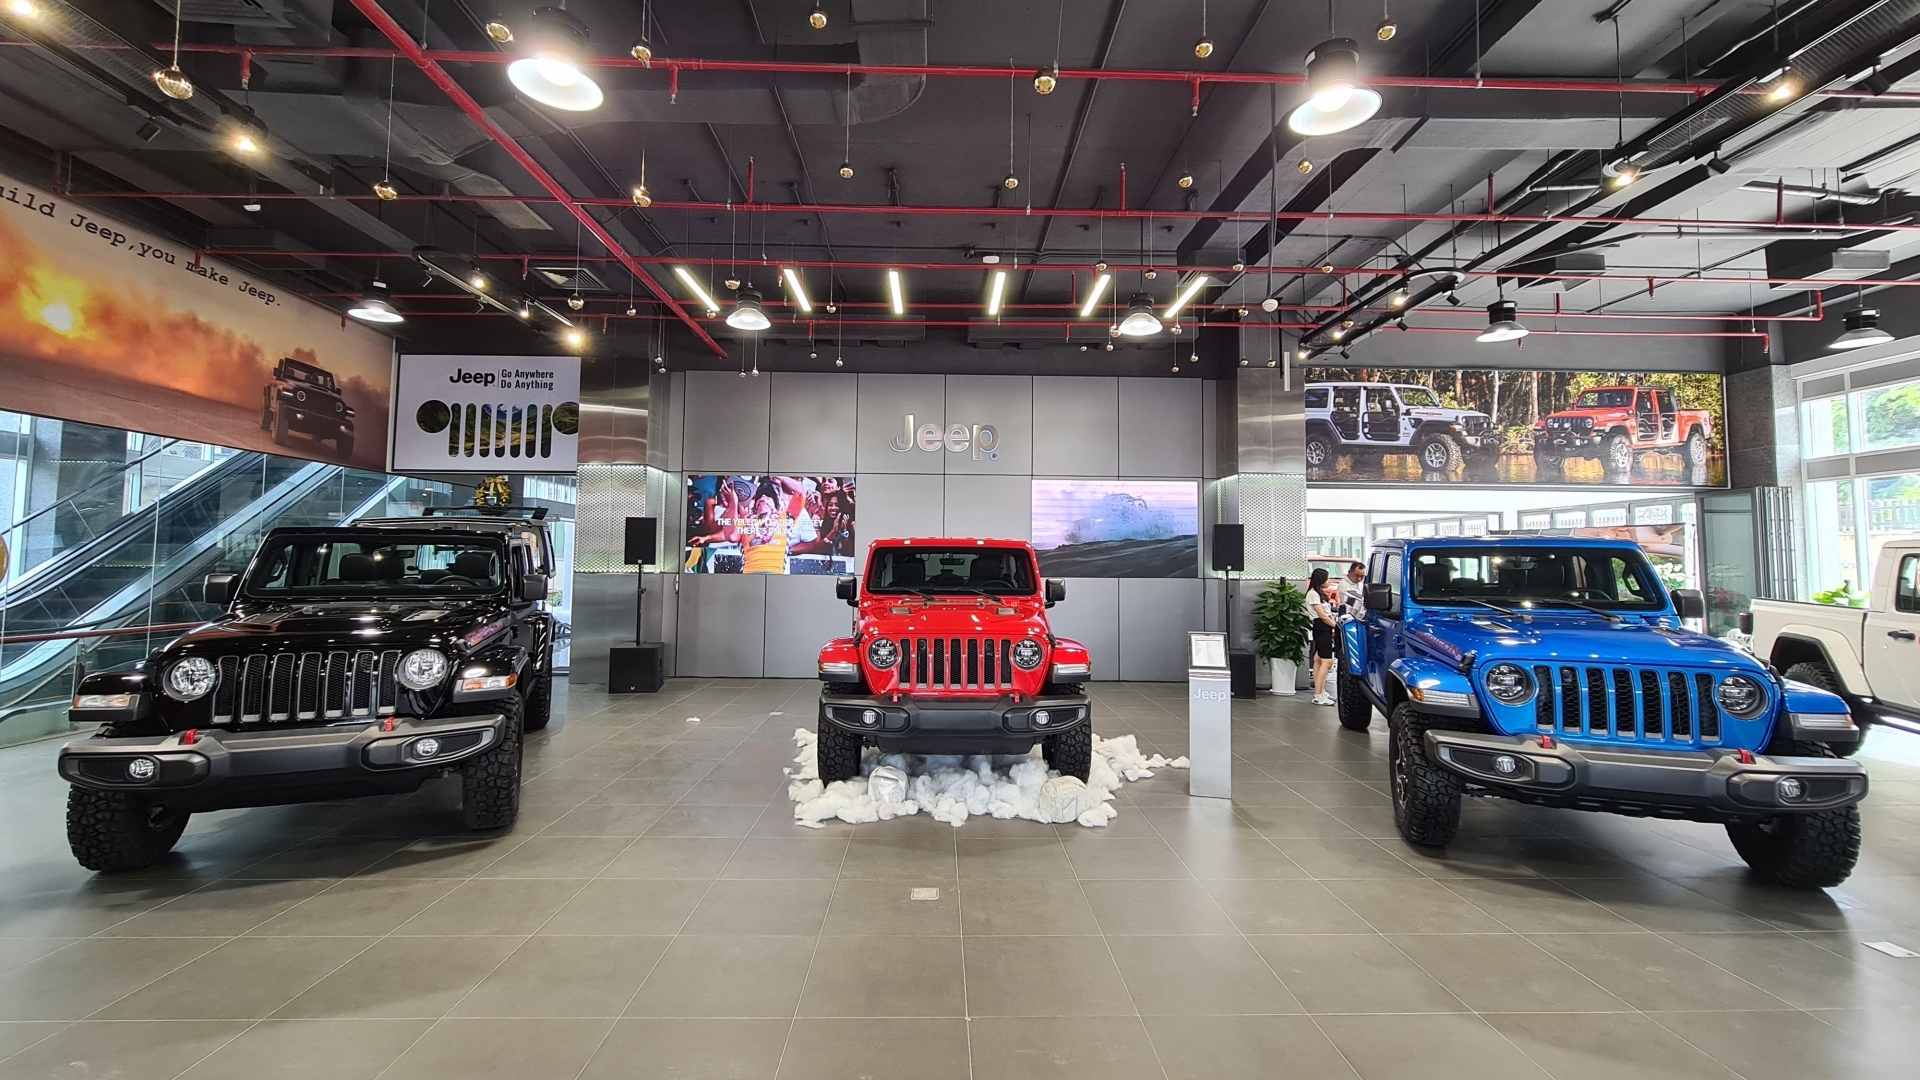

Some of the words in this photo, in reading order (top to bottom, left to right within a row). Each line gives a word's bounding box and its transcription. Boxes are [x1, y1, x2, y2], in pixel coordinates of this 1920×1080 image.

[0, 186, 56, 218] ild
[185, 261, 229, 285] make
[238, 281, 280, 307] Jeep.
[449, 368, 496, 387] Jeep
[501, 369, 512, 378] Go
[515, 369, 554, 379] Anywhere
[501, 380, 512, 389] Do
[515, 380, 554, 391] Anything
[889, 414, 999, 460] Jeep
[736, 527, 767, 535] THERE'S
[1193, 688, 1227, 703] Jeep
